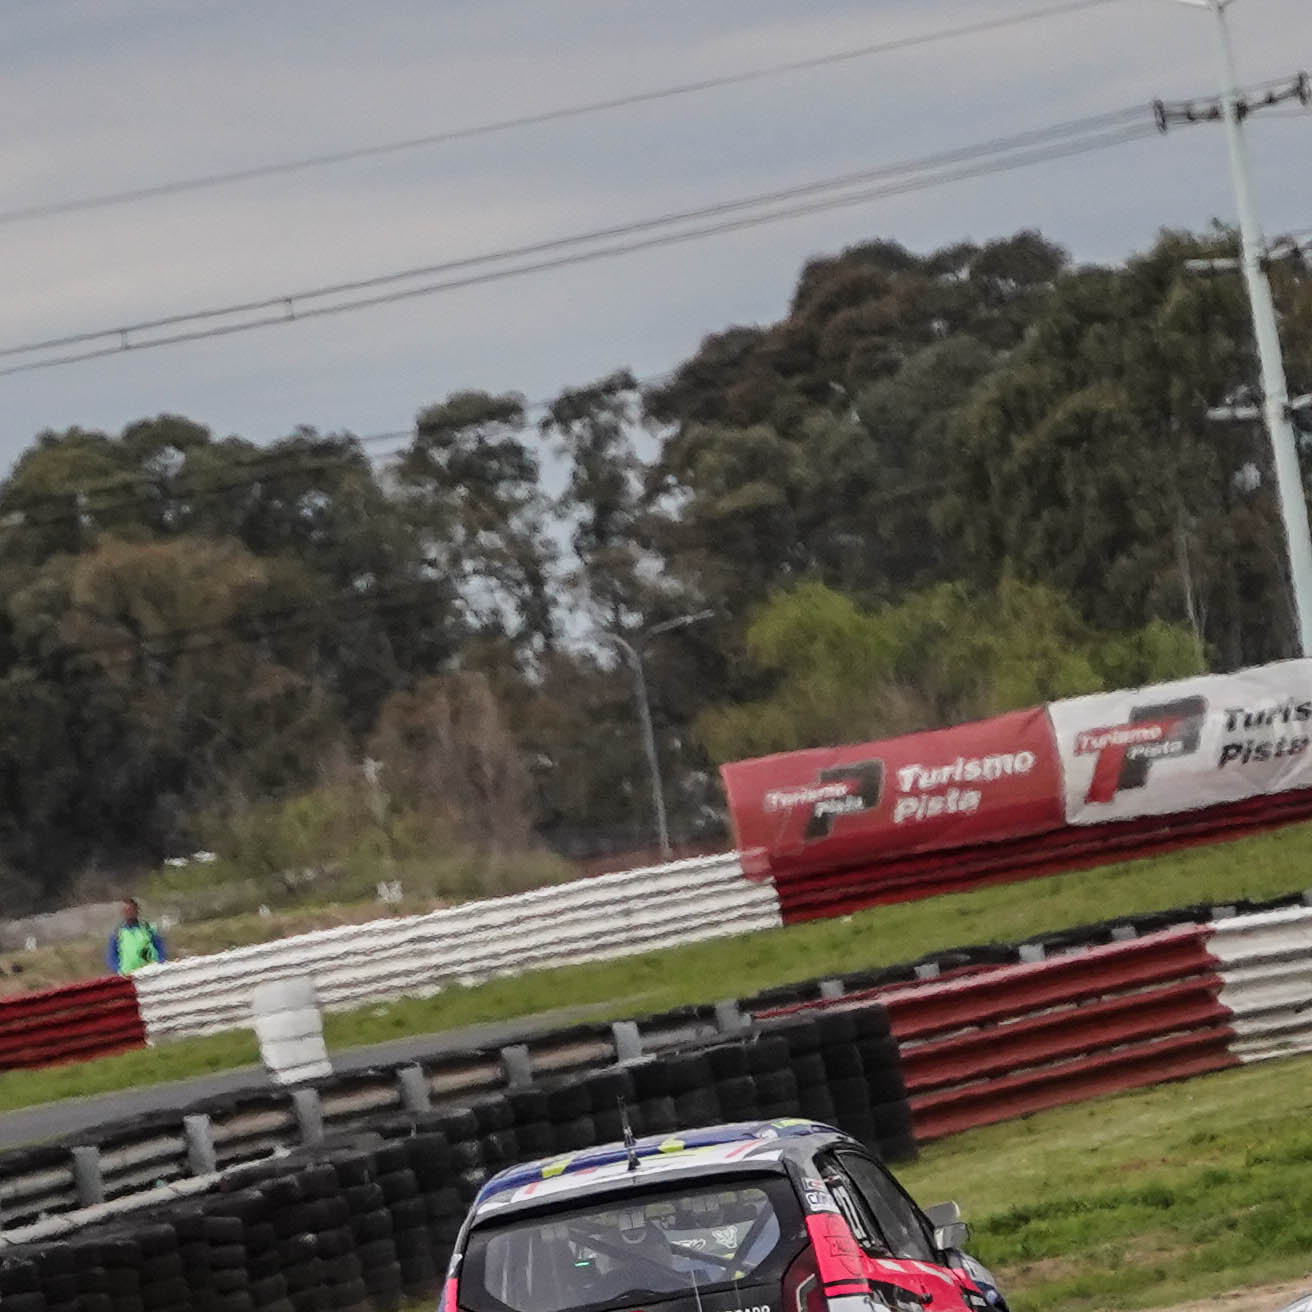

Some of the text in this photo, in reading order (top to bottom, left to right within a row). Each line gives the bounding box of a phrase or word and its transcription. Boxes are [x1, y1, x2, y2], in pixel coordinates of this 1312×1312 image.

[1217, 736, 1310, 769] Pista
[897, 751, 1036, 792] Turismo
[893, 788, 982, 823] Pista
